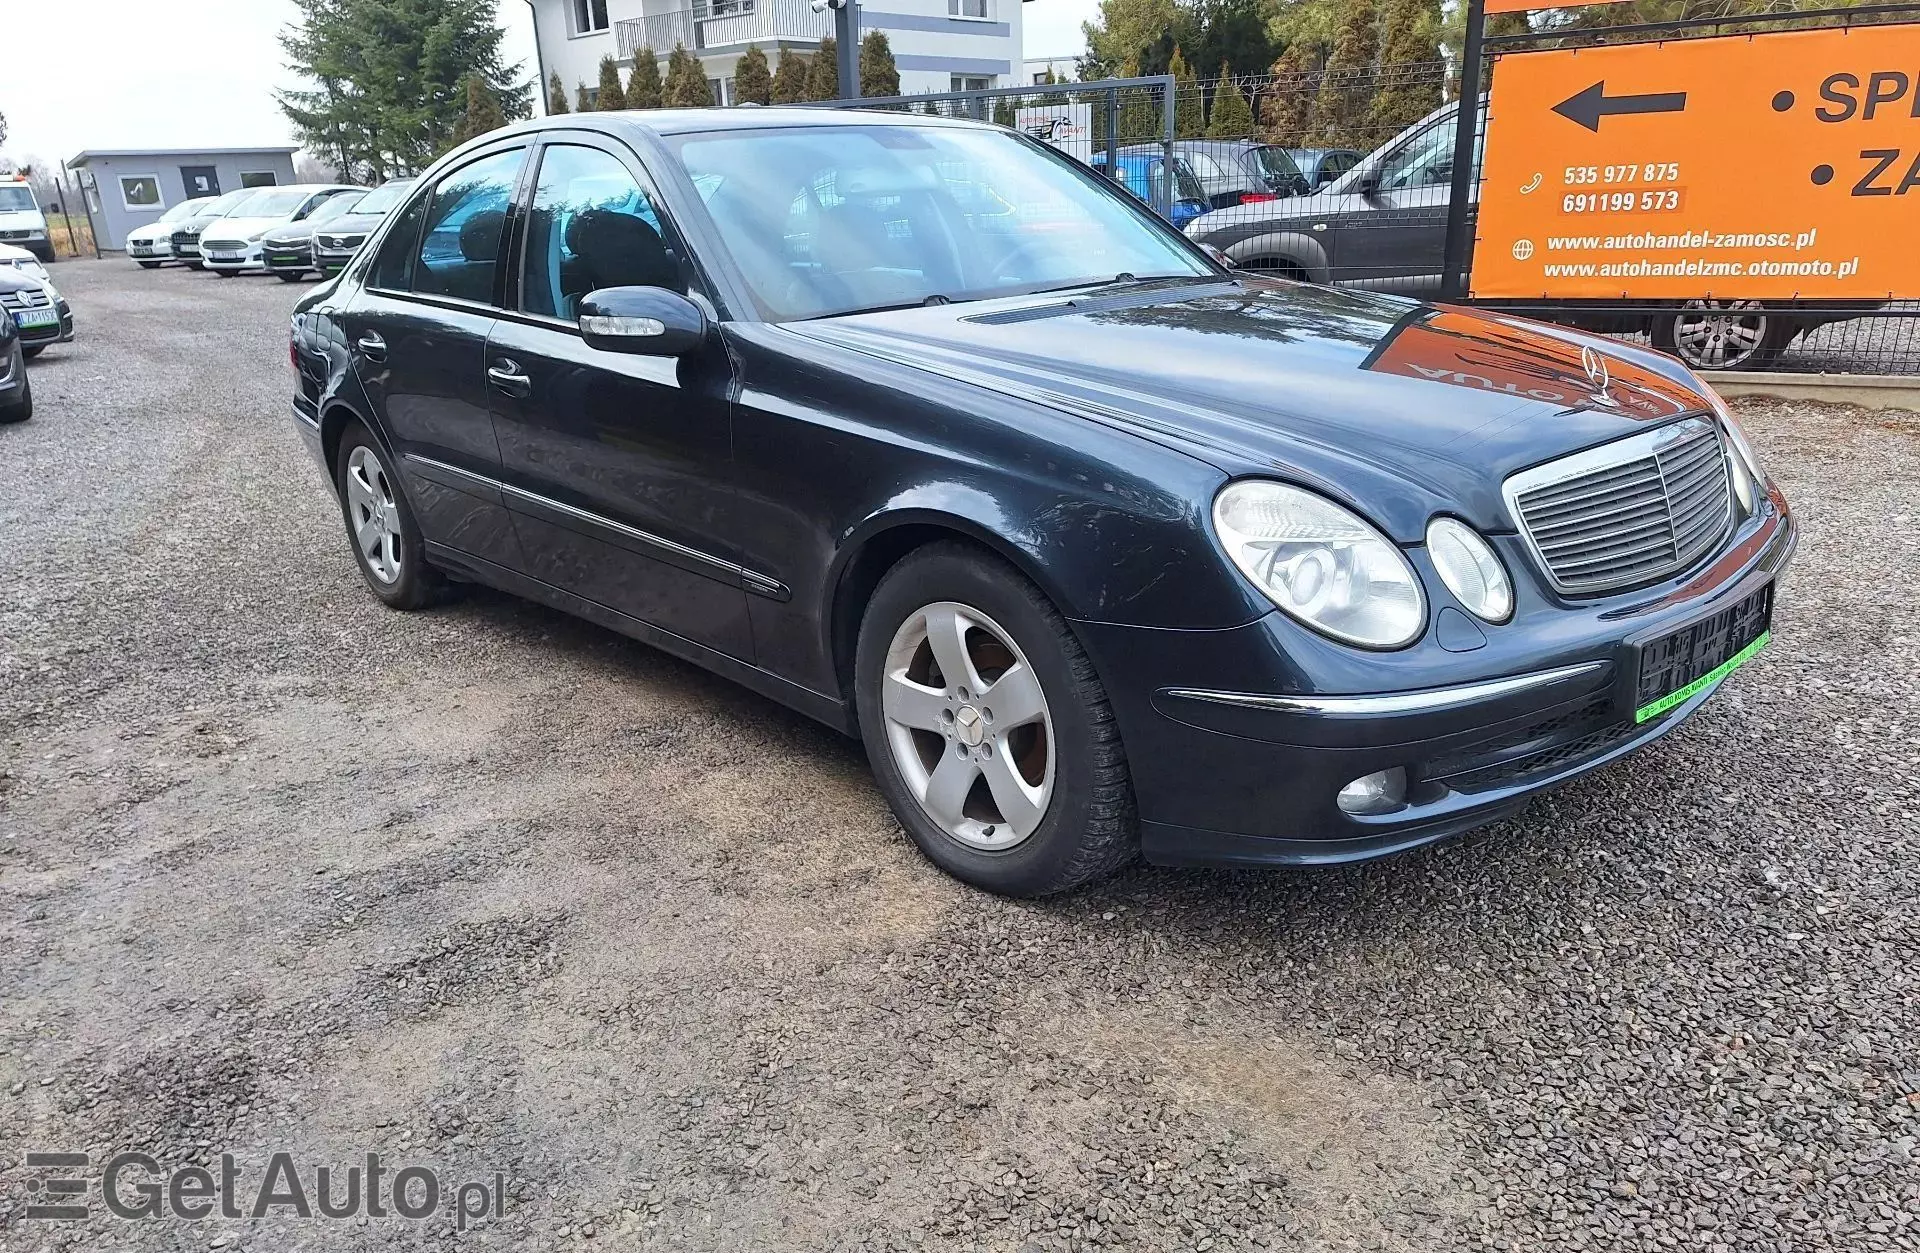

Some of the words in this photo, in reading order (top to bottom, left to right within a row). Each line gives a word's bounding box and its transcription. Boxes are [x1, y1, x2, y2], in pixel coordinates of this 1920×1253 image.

[1815, 70, 1920, 123] SP
[1564, 166, 1598, 184] 535
[1603, 164, 1638, 183] 977
[1643, 162, 1679, 182] 875
[1640, 190, 1679, 210] 573
[1547, 228, 1817, 251] www.autohandel-zamosc.pl
[1544, 256, 1859, 279] www.autohandelzmc.otomoto.pl
[1659, 695, 1674, 709] AUTO
